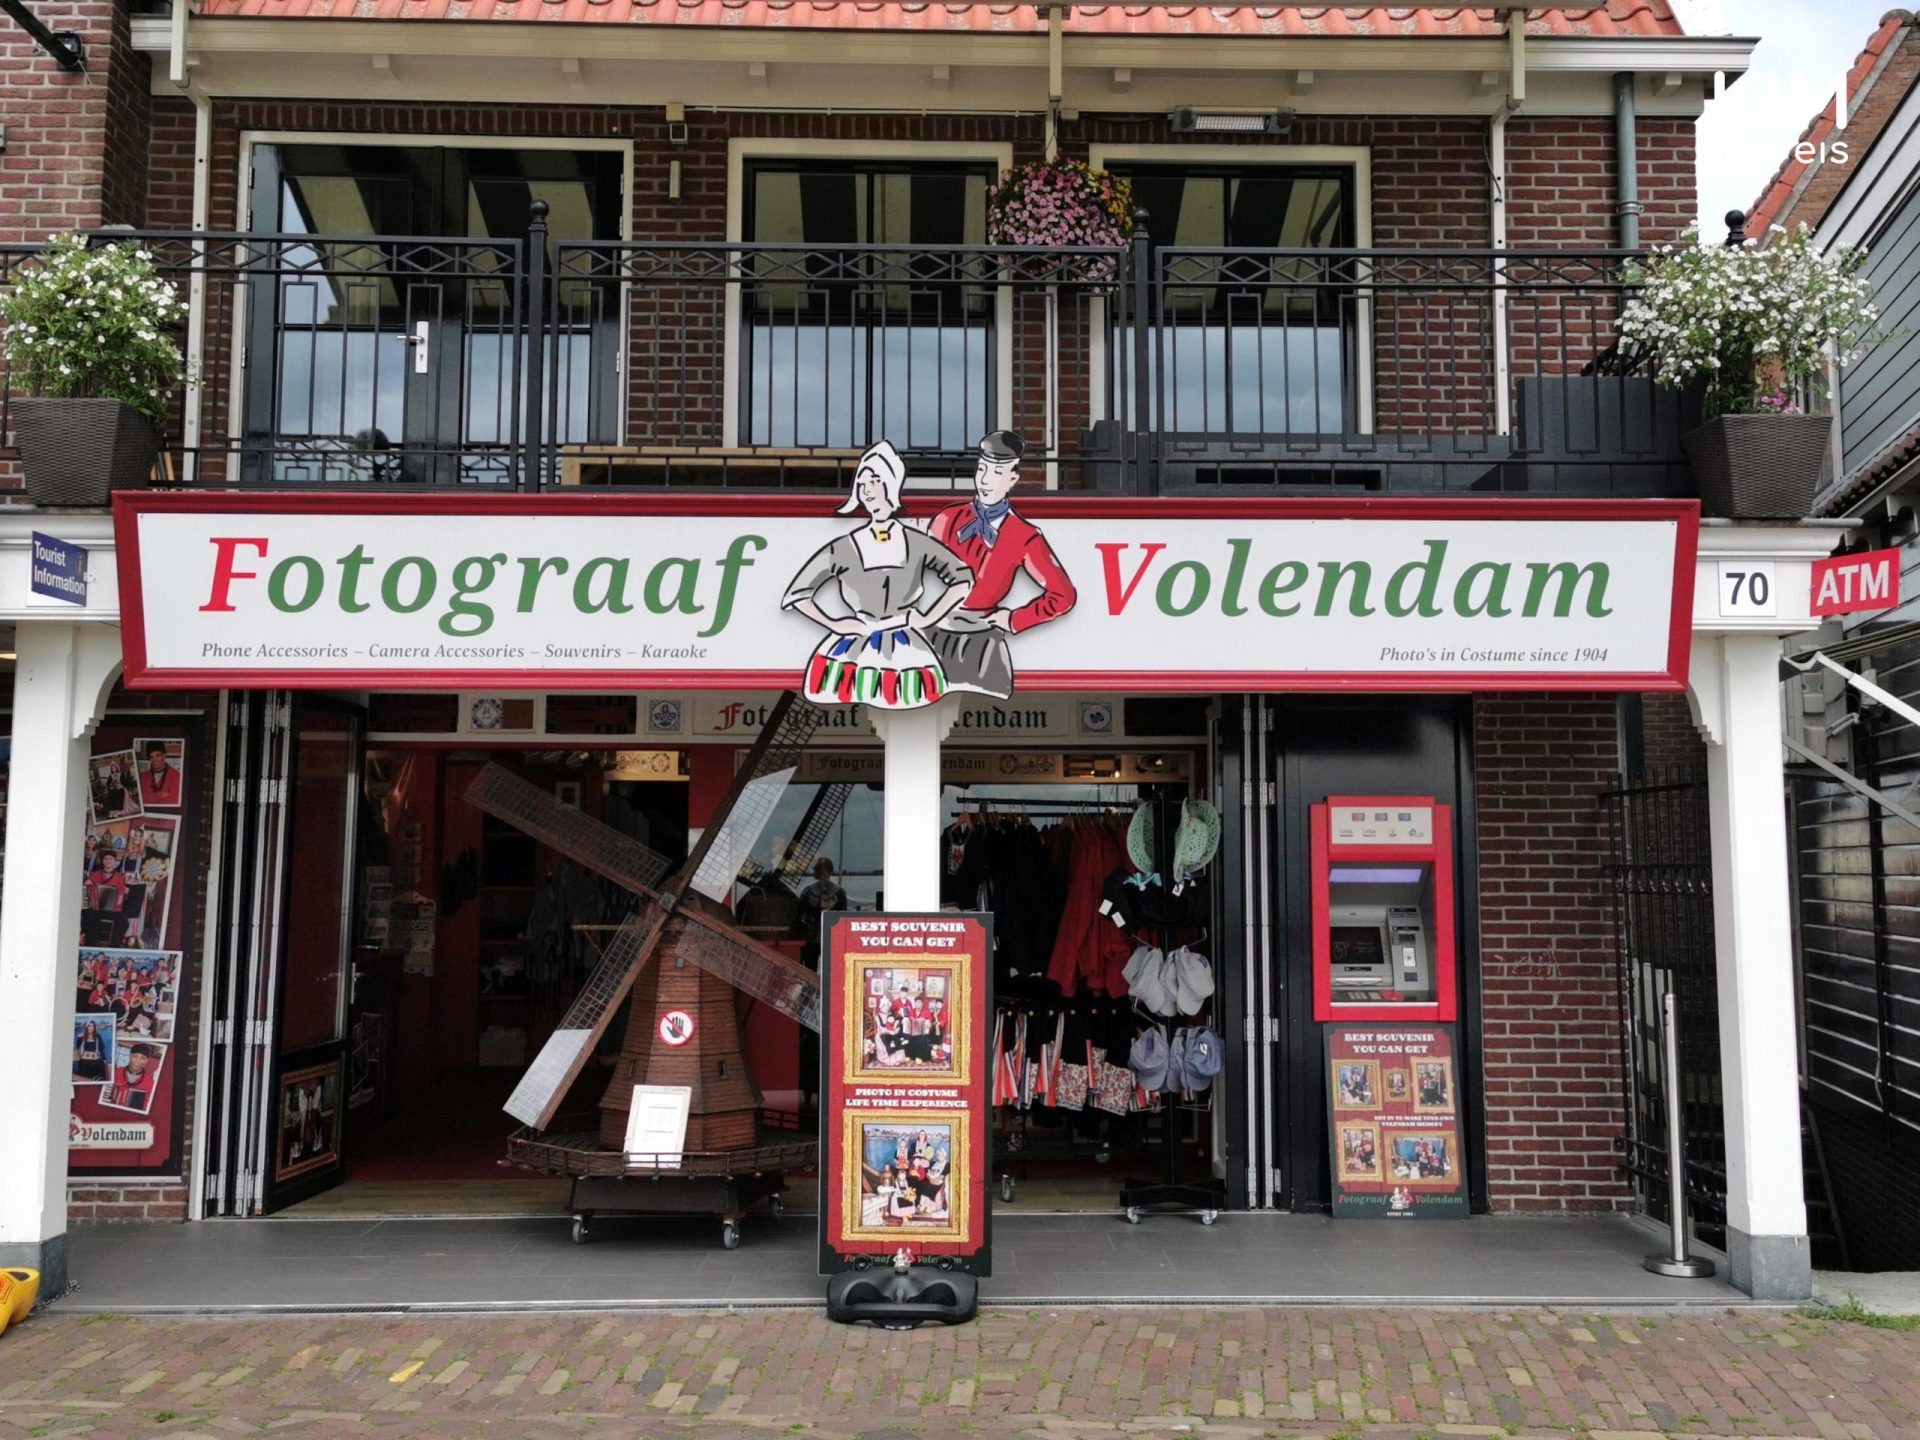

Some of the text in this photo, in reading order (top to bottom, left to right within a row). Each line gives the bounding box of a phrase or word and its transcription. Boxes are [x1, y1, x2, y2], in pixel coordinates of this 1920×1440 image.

[34, 541, 66, 567] Tourist
[34, 565, 85, 596] Information
[199, 535, 1613, 638] Fotograaf Volendam
[1816, 560, 1890, 607] ATM
[1726, 572, 1769, 606] 70
[201, 643, 252, 658] Phone
[256, 643, 348, 658] Accessories
[369, 643, 430, 658] Camera
[434, 643, 525, 658] Accessories
[545, 643, 622, 658] Souvenirs
[641, 643, 708, 658] Karaoke
[1380, 647, 1608, 662] Photo's in Costume since 1904
[851, 922, 966, 932] BEST SOUVENIR
[860, 936, 956, 947] YOU CAN GET
[1344, 1033, 1435, 1042] BEST SOUVENIR
[1353, 1045, 1428, 1053] YOU CAN GET
[855, 1088, 958, 1097] PHOTO IN COSTUME
[901, 1099, 968, 1108] EXPERIENCE
[81, 1128, 146, 1141] Volendam
[1339, 1194, 1463, 1206] Fotograaf Volendam
